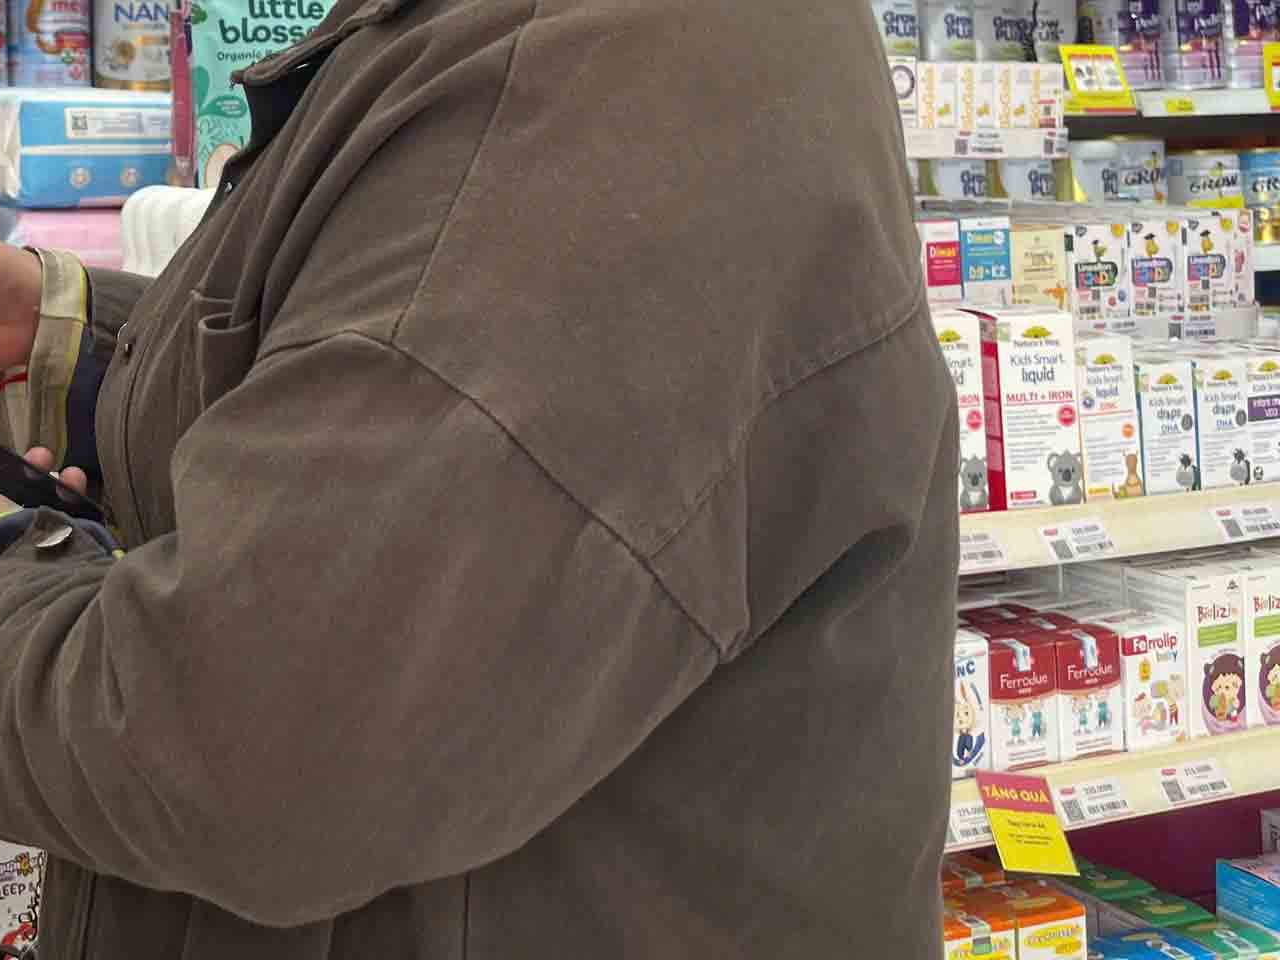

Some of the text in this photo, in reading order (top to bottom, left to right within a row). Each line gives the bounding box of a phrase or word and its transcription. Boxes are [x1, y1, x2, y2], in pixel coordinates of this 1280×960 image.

[114, 1, 170, 23] NAN
[1010, 353, 1063, 366] Kids Smart
[1022, 367, 1054, 384] liquid
[1048, 391, 1072, 401] IRON
[1000, 672, 1048, 689] Ferrodue
